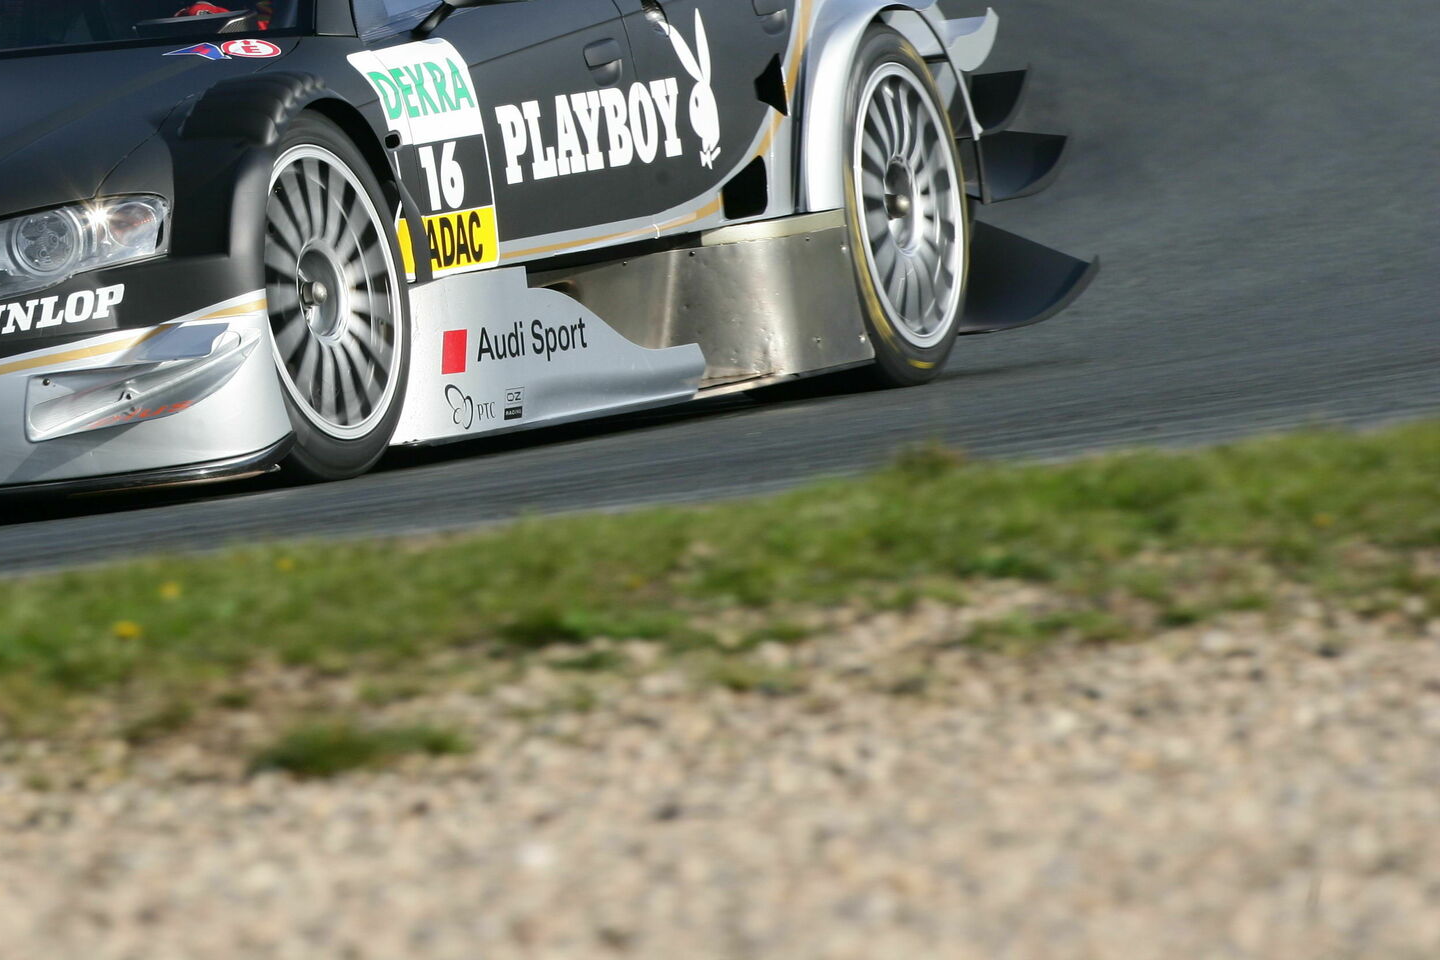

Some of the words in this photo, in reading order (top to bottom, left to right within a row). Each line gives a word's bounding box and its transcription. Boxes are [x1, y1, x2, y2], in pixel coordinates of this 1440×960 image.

[366, 57, 476, 121] DEKRA
[494, 76, 683, 186] PLAYBOY
[418, 140, 466, 211] 16
[427, 210, 483, 268] ADAC
[477, 320, 526, 362] Audi
[530, 317, 588, 362] Sport
[477, 401, 496, 421] PTC
[506, 391, 522, 402] OZ
